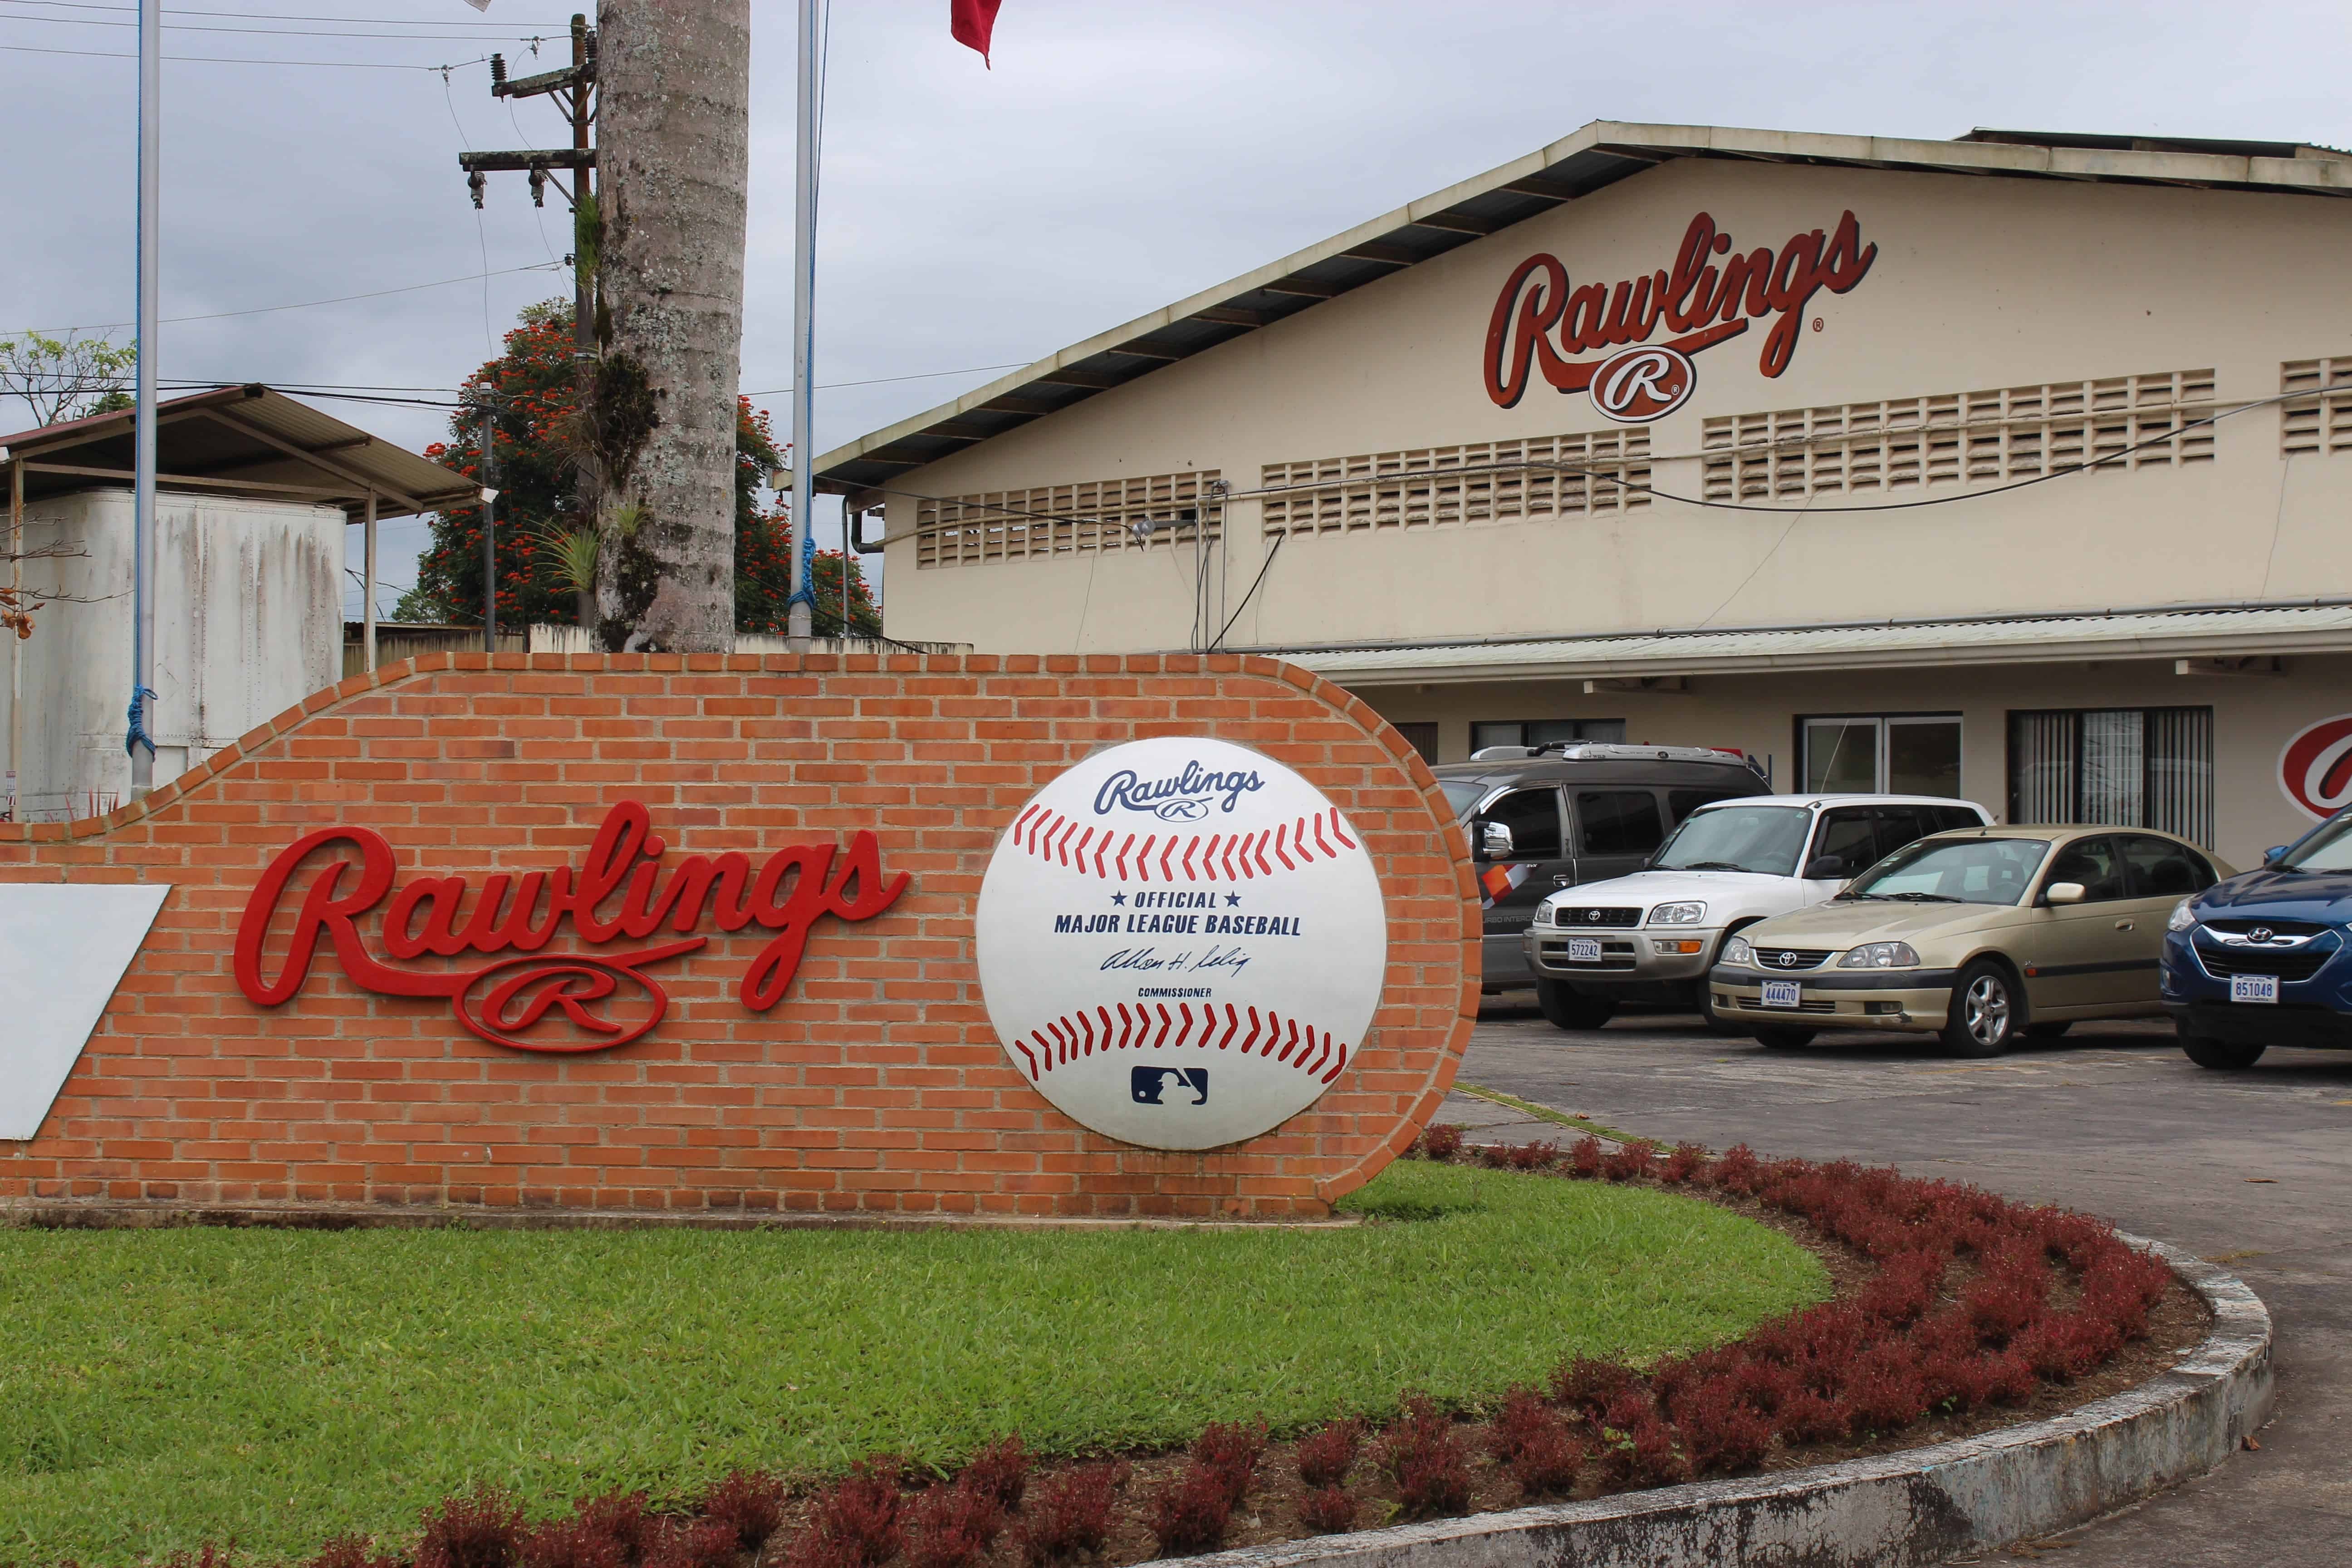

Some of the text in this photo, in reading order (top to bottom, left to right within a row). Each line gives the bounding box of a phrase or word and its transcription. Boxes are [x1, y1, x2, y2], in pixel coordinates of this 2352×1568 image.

[1484, 209, 1878, 409] Rawlings
[1094, 760, 1266, 815] Rawlings
[234, 801, 910, 1011] Rawlings
[1134, 892, 1216, 908] OFFICIAL
[1054, 914, 1301, 936] MAJOR LEAGUE BASEBALL
[1572, 944, 1597, 956] 572242
[1138, 987, 1212, 998] COMMISSIONER
[1766, 988, 1796, 1001] 444470
[2236, 982, 2272, 997] 851048
